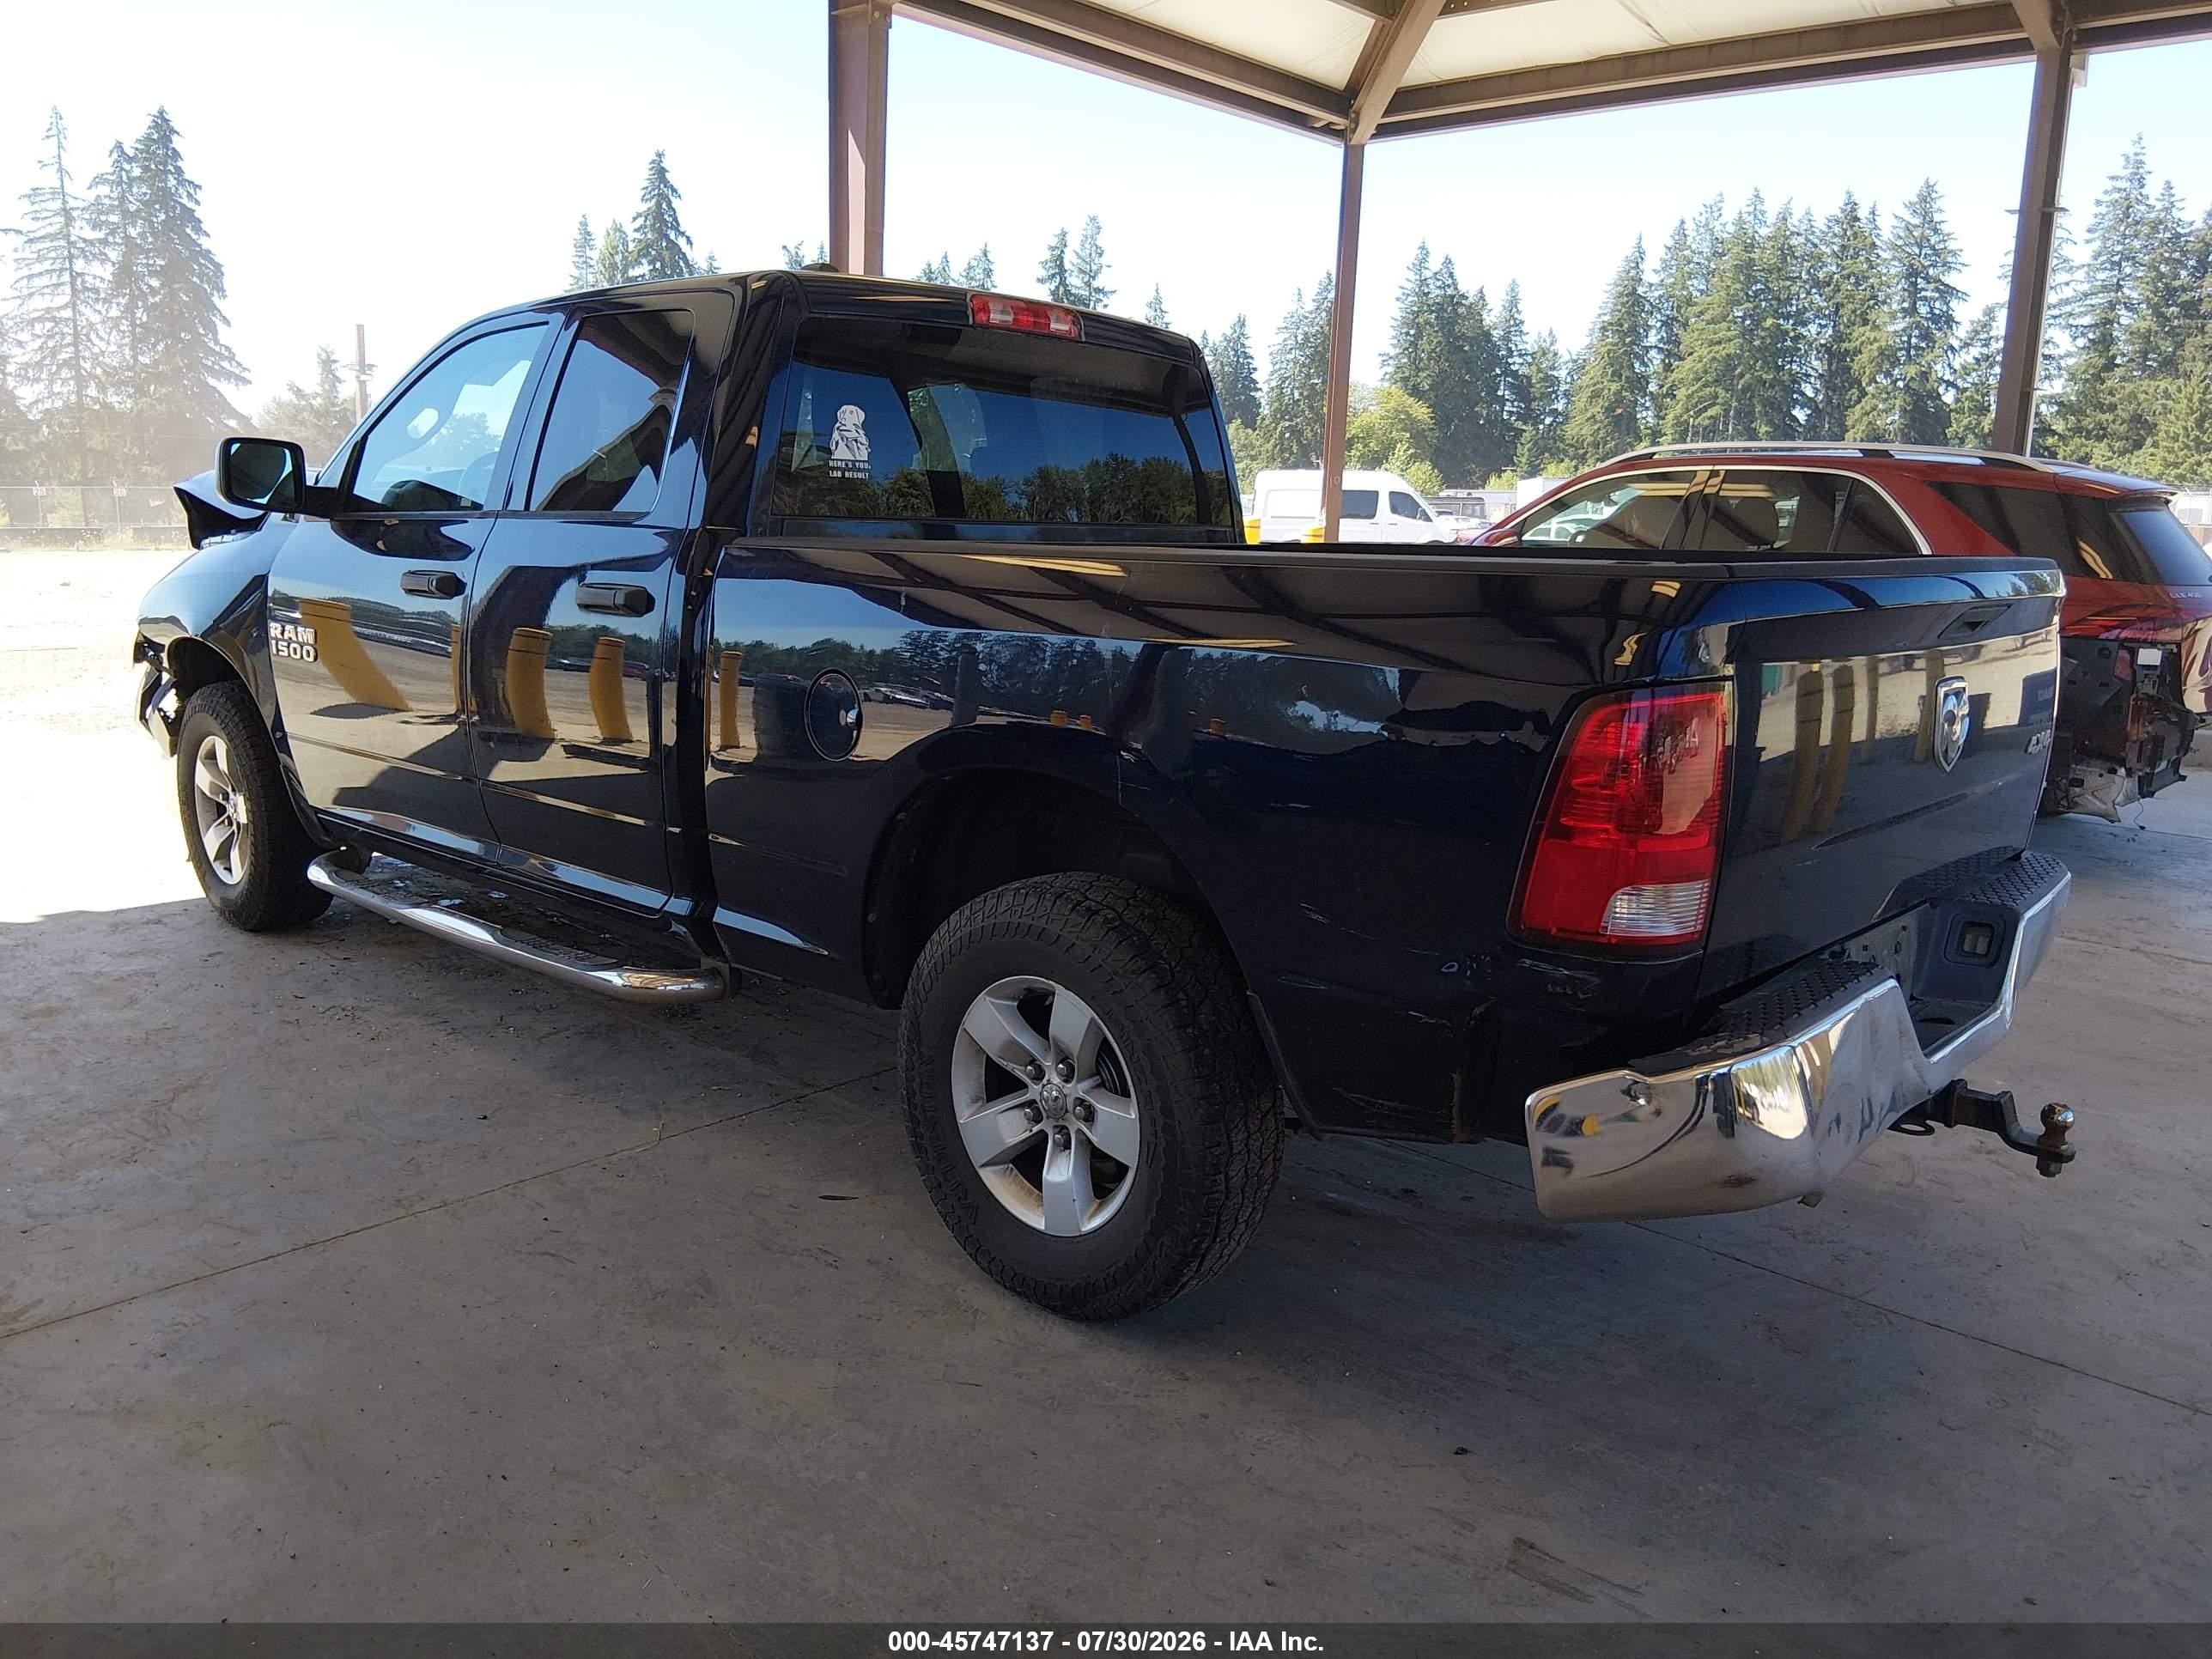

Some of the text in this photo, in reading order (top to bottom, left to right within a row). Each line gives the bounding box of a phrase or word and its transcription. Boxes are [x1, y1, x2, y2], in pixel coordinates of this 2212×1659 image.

[829, 459, 853, 469] HERE'S
[829, 470, 870, 479] LAB RESULT
[270, 622, 317, 645] RAM
[270, 639, 318, 663] 1500
